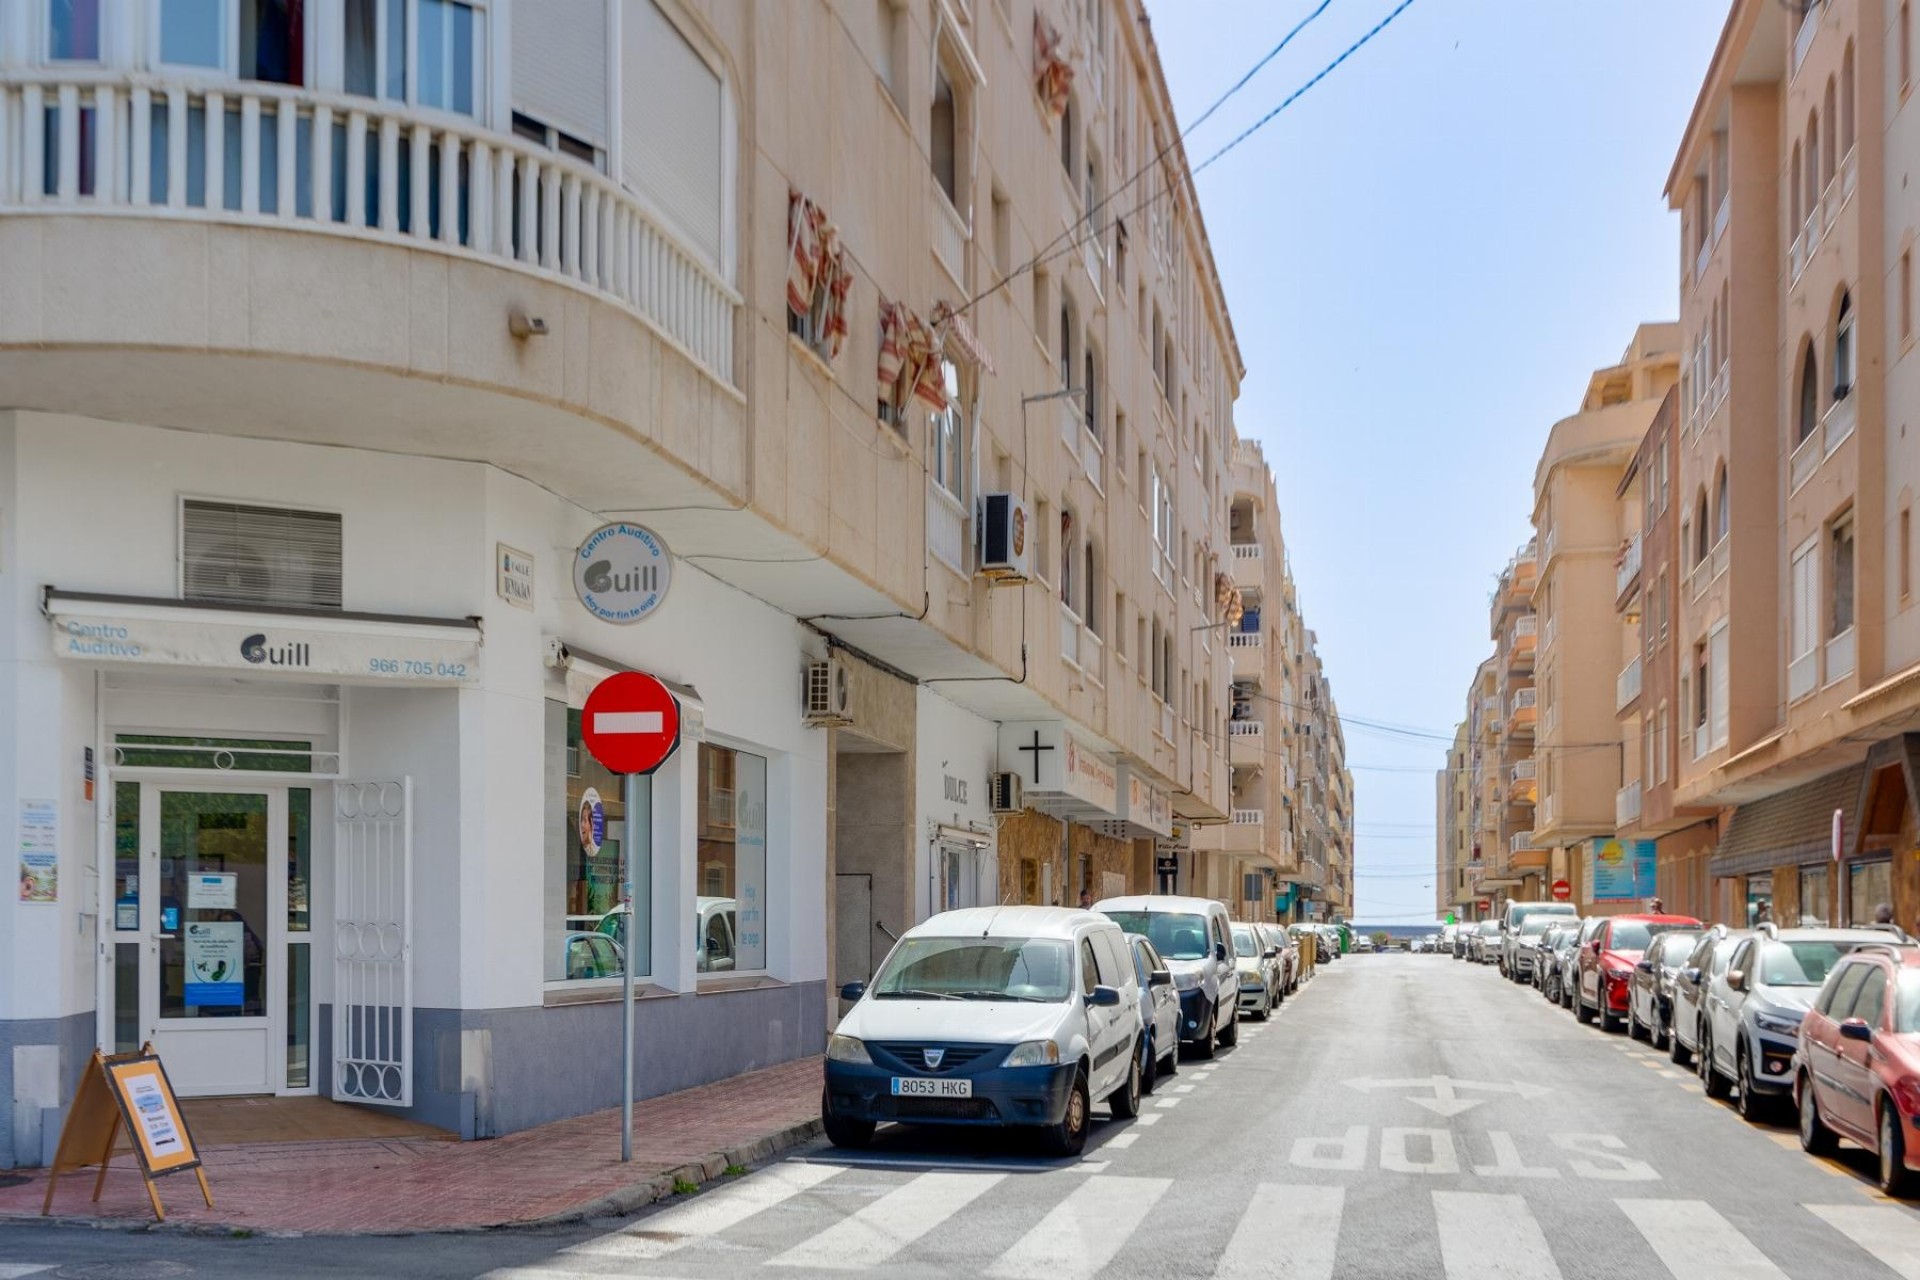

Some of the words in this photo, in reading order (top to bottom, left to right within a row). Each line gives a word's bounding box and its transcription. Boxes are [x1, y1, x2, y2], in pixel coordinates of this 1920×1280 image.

[580, 527, 615, 559] Centro
[617, 524, 660, 557] Auditivo
[584, 559, 658, 593] Guill
[585, 593, 600, 612] Hoy
[599, 607, 615, 618] por
[616, 610, 630, 619] fin
[629, 607, 640, 617] te
[639, 593, 658, 612] oigo
[66, 621, 129, 639] Centro
[68, 639, 141, 657] Auditivo
[240, 633, 310, 667] Guill
[369, 657, 399, 673] 966
[404, 659, 434, 676] 705
[436, 661, 467, 678] 042
[944, 773, 968, 805] DULCE
[901, 1080, 935, 1094] 8053
[941, 1081, 967, 1095] HKG
[1289, 1124, 1662, 1181] STOP
